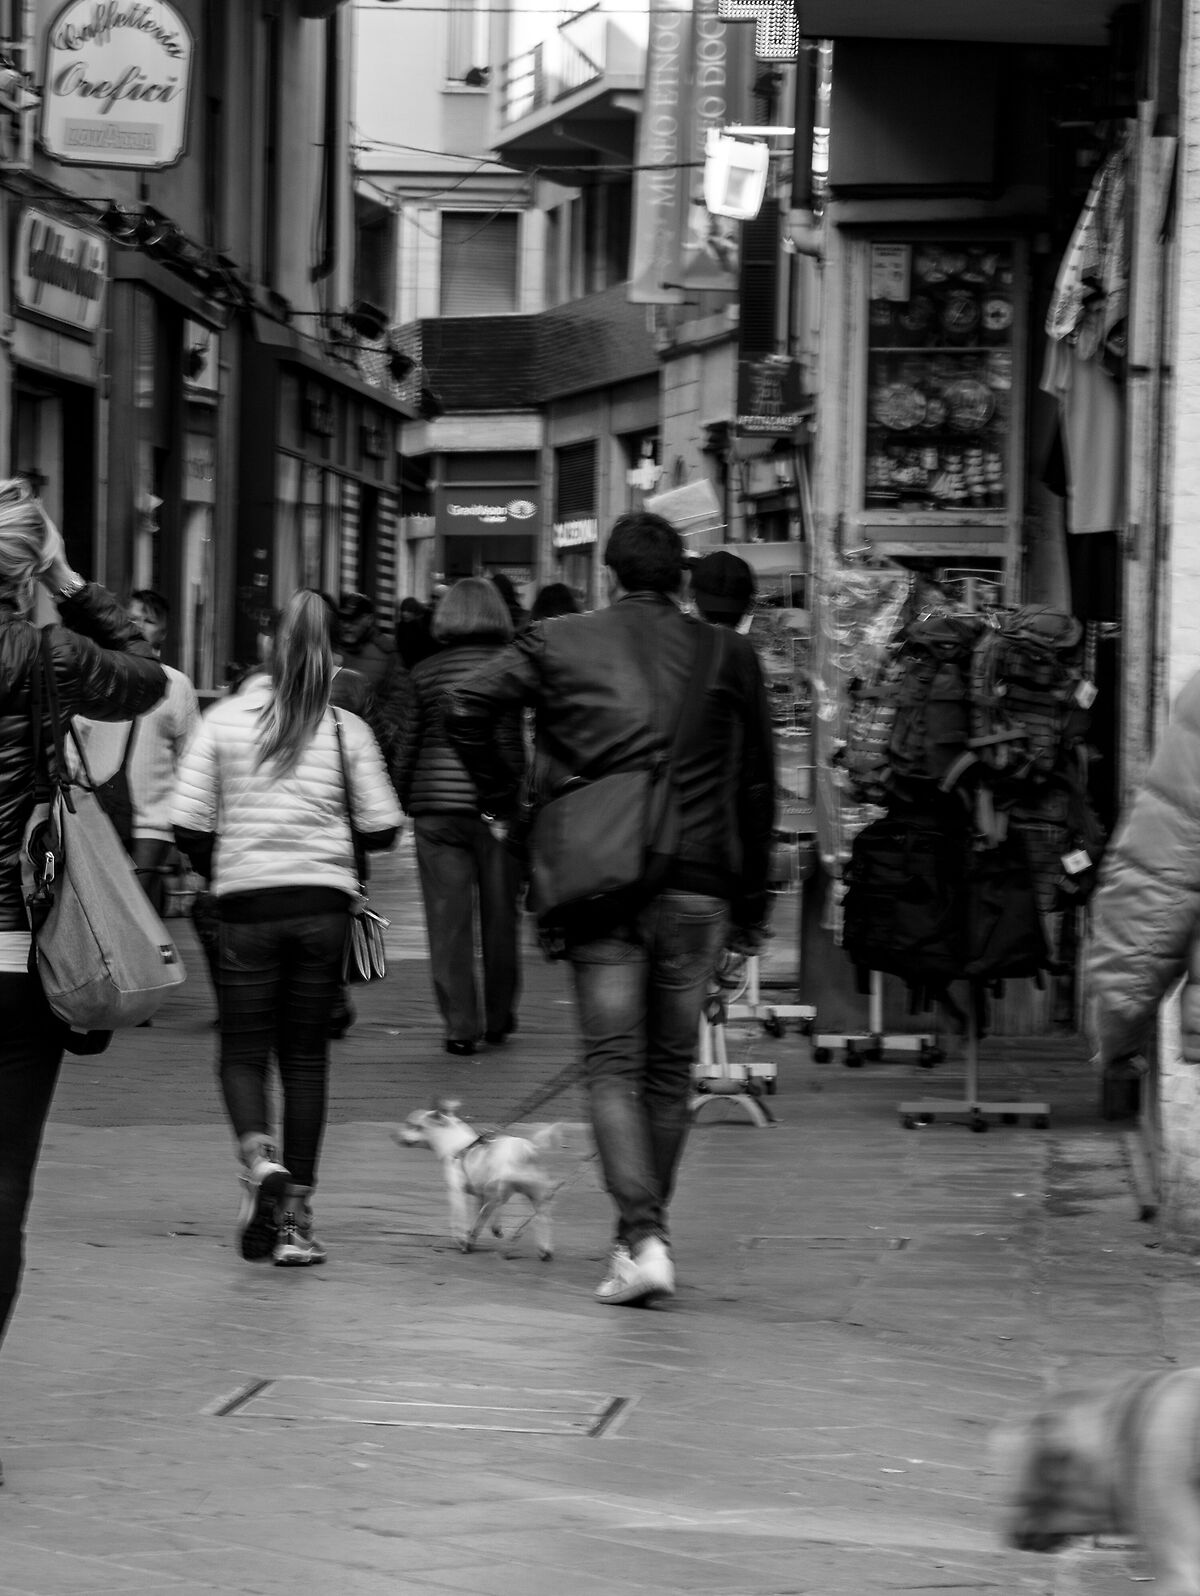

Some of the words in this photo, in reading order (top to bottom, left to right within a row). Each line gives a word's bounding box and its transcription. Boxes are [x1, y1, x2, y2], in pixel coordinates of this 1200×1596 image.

[53, 1, 186, 59] Caffetteria
[54, 61, 185, 115] Orefici
[648, 115, 678, 207] MUSEO
